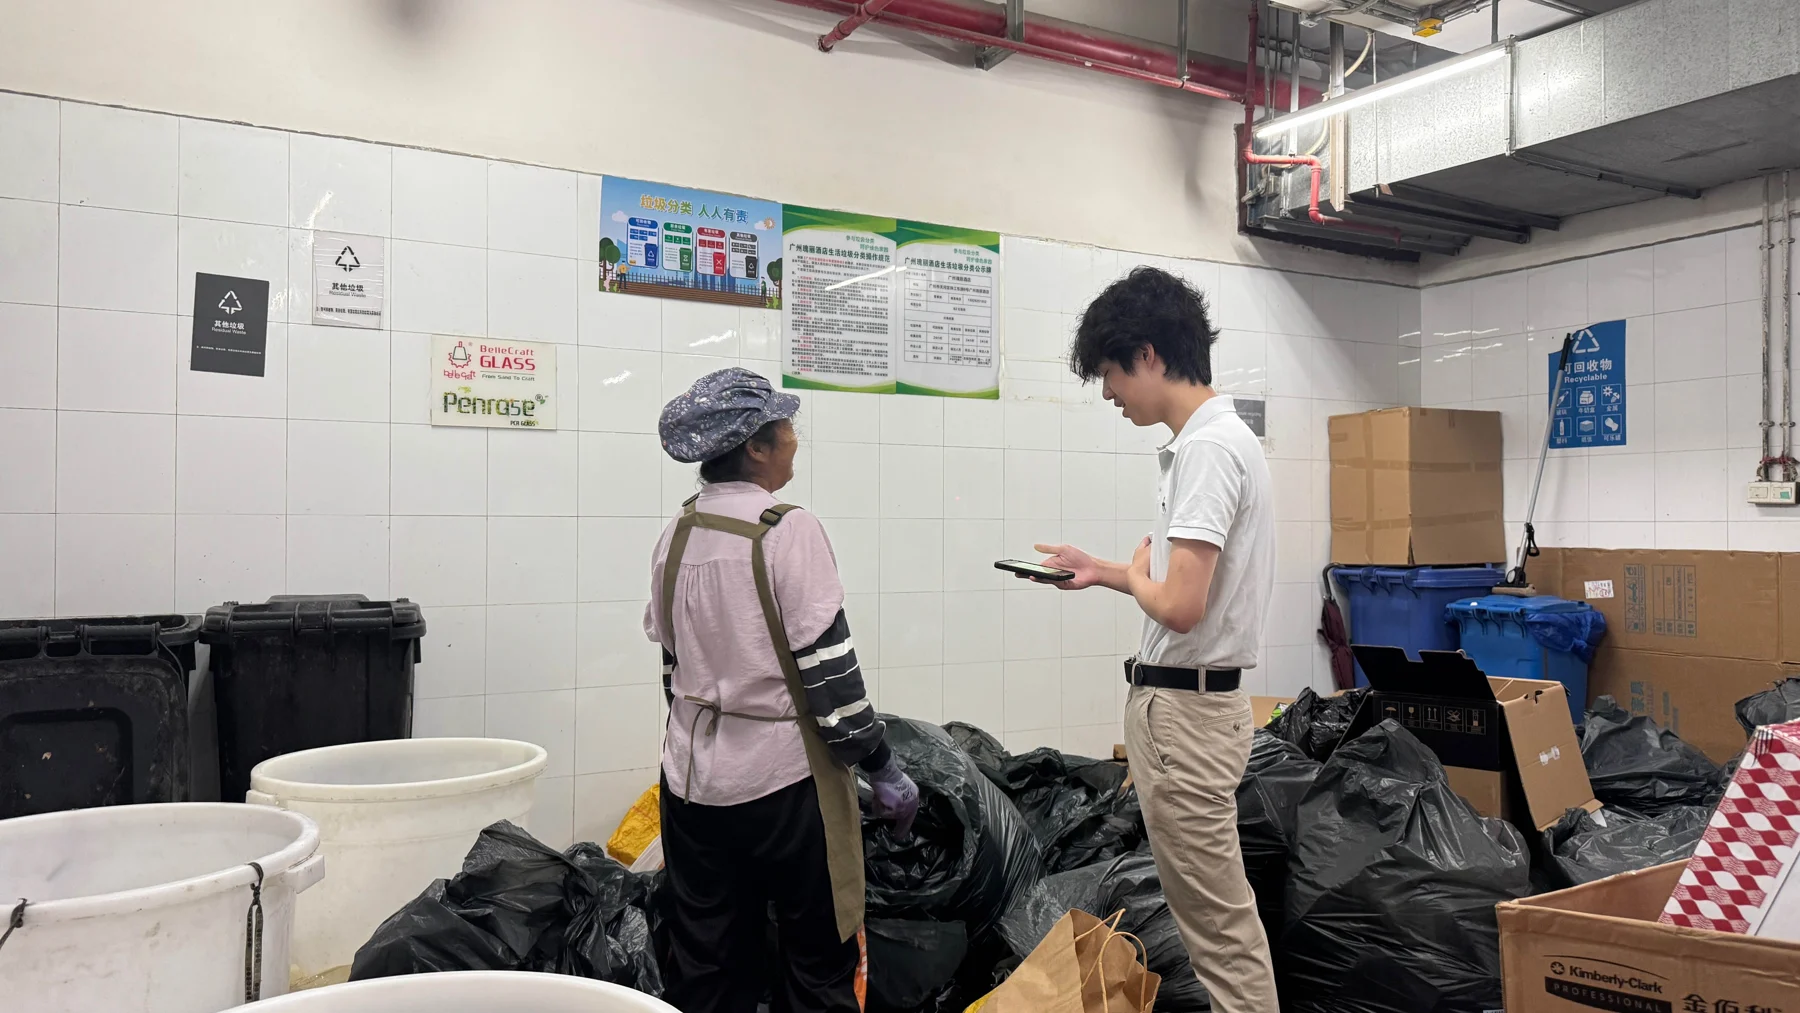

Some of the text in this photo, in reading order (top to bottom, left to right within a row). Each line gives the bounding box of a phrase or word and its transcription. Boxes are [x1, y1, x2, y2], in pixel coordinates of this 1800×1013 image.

[640, 195, 748, 223] 垃圾分类 人人有责
[332, 282, 364, 292] 其他垃圾
[214, 320, 245, 330] 其他垃圾
[480, 344, 534, 356] BelleCraft
[480, 355, 536, 371] GLASS
[1563, 358, 1612, 375] 可回收物
[1564, 375, 1608, 383] Recyclable
[1569, 965, 1663, 994] Kimberly-Clark
[1553, 983, 1662, 1013] PROFESSIONAL
